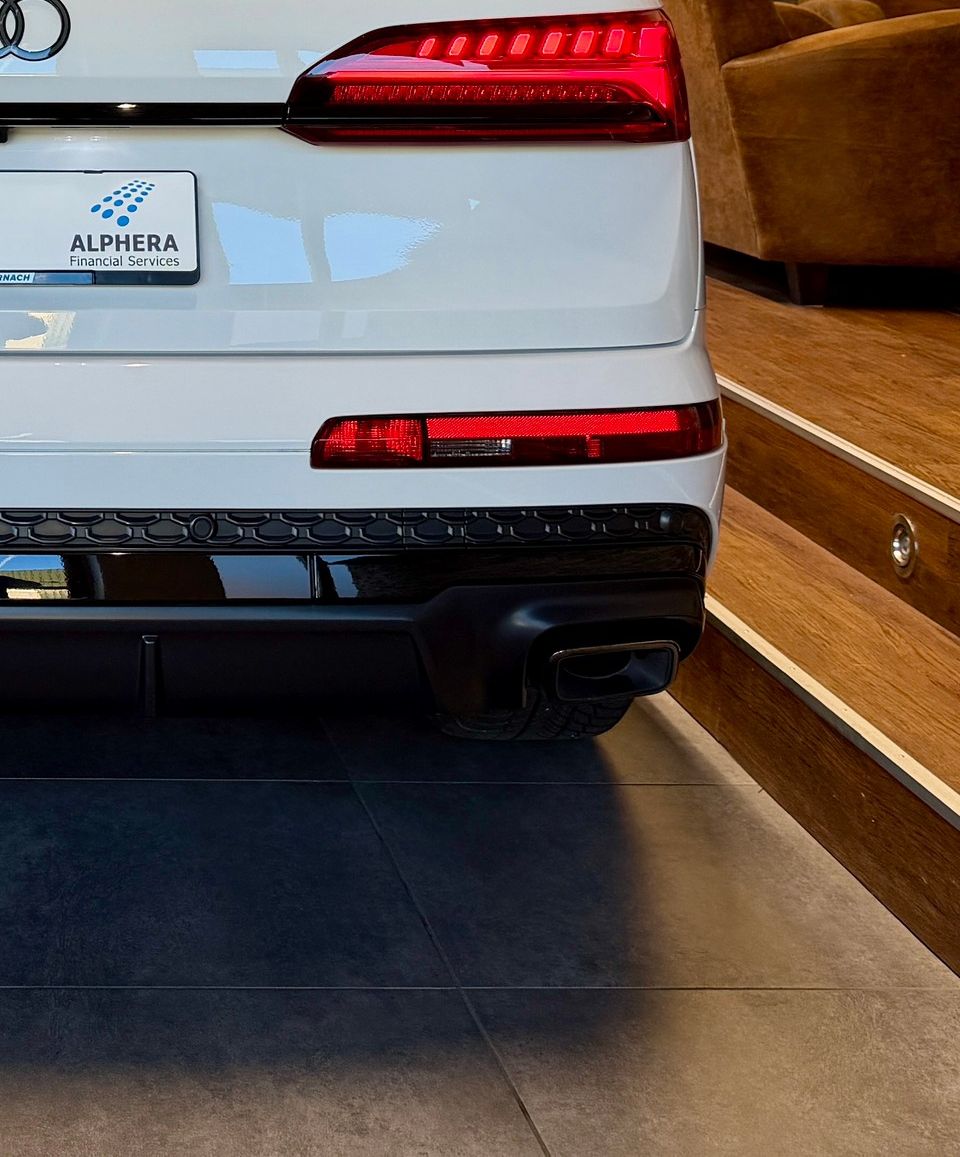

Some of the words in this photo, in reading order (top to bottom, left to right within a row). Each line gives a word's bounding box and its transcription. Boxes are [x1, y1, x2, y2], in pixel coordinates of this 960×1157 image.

[70, 234, 179, 252] ALPHERA
[70, 255, 123, 267] Financial
[128, 255, 180, 267] Services
